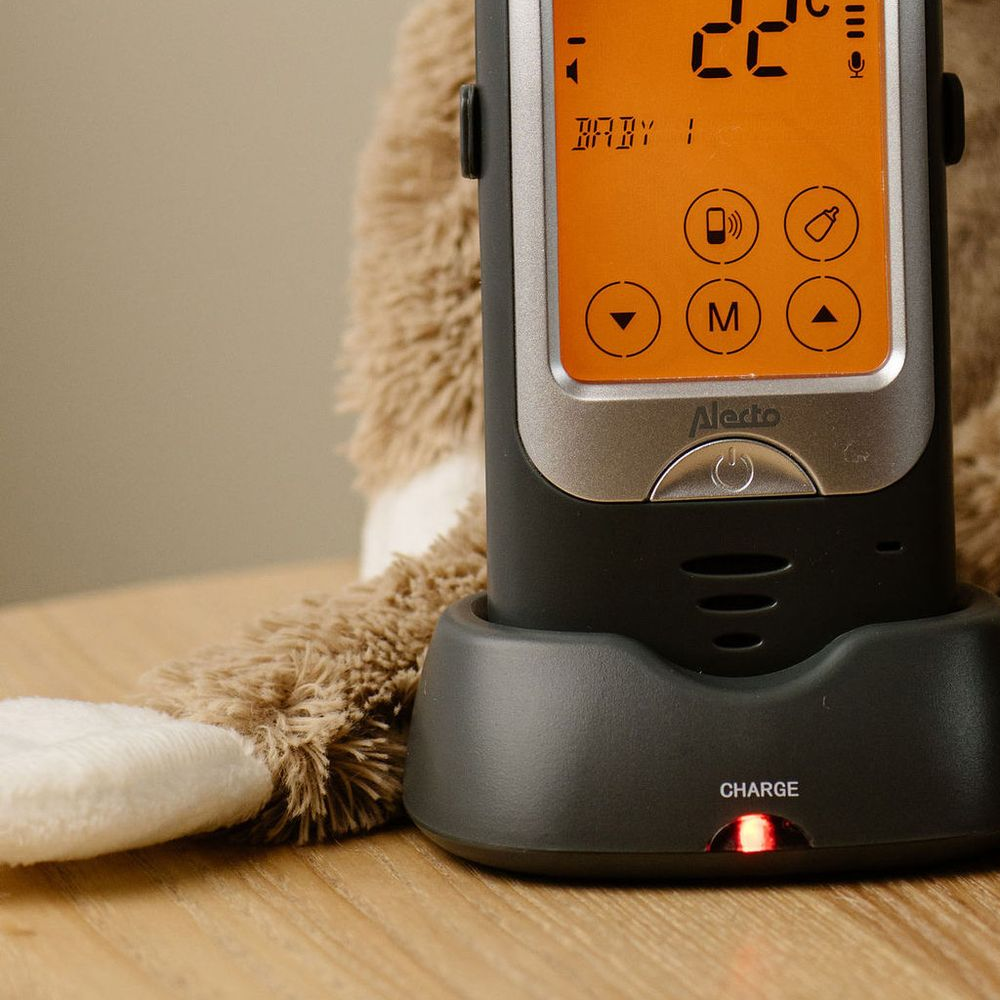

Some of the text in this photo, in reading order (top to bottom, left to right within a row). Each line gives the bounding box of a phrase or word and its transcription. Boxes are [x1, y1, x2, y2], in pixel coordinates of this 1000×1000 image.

[571, 116, 654, 150] BABY
[708, 301, 739, 332] M
[688, 402, 781, 438] Alecto
[719, 781, 800, 799] CHARGE
